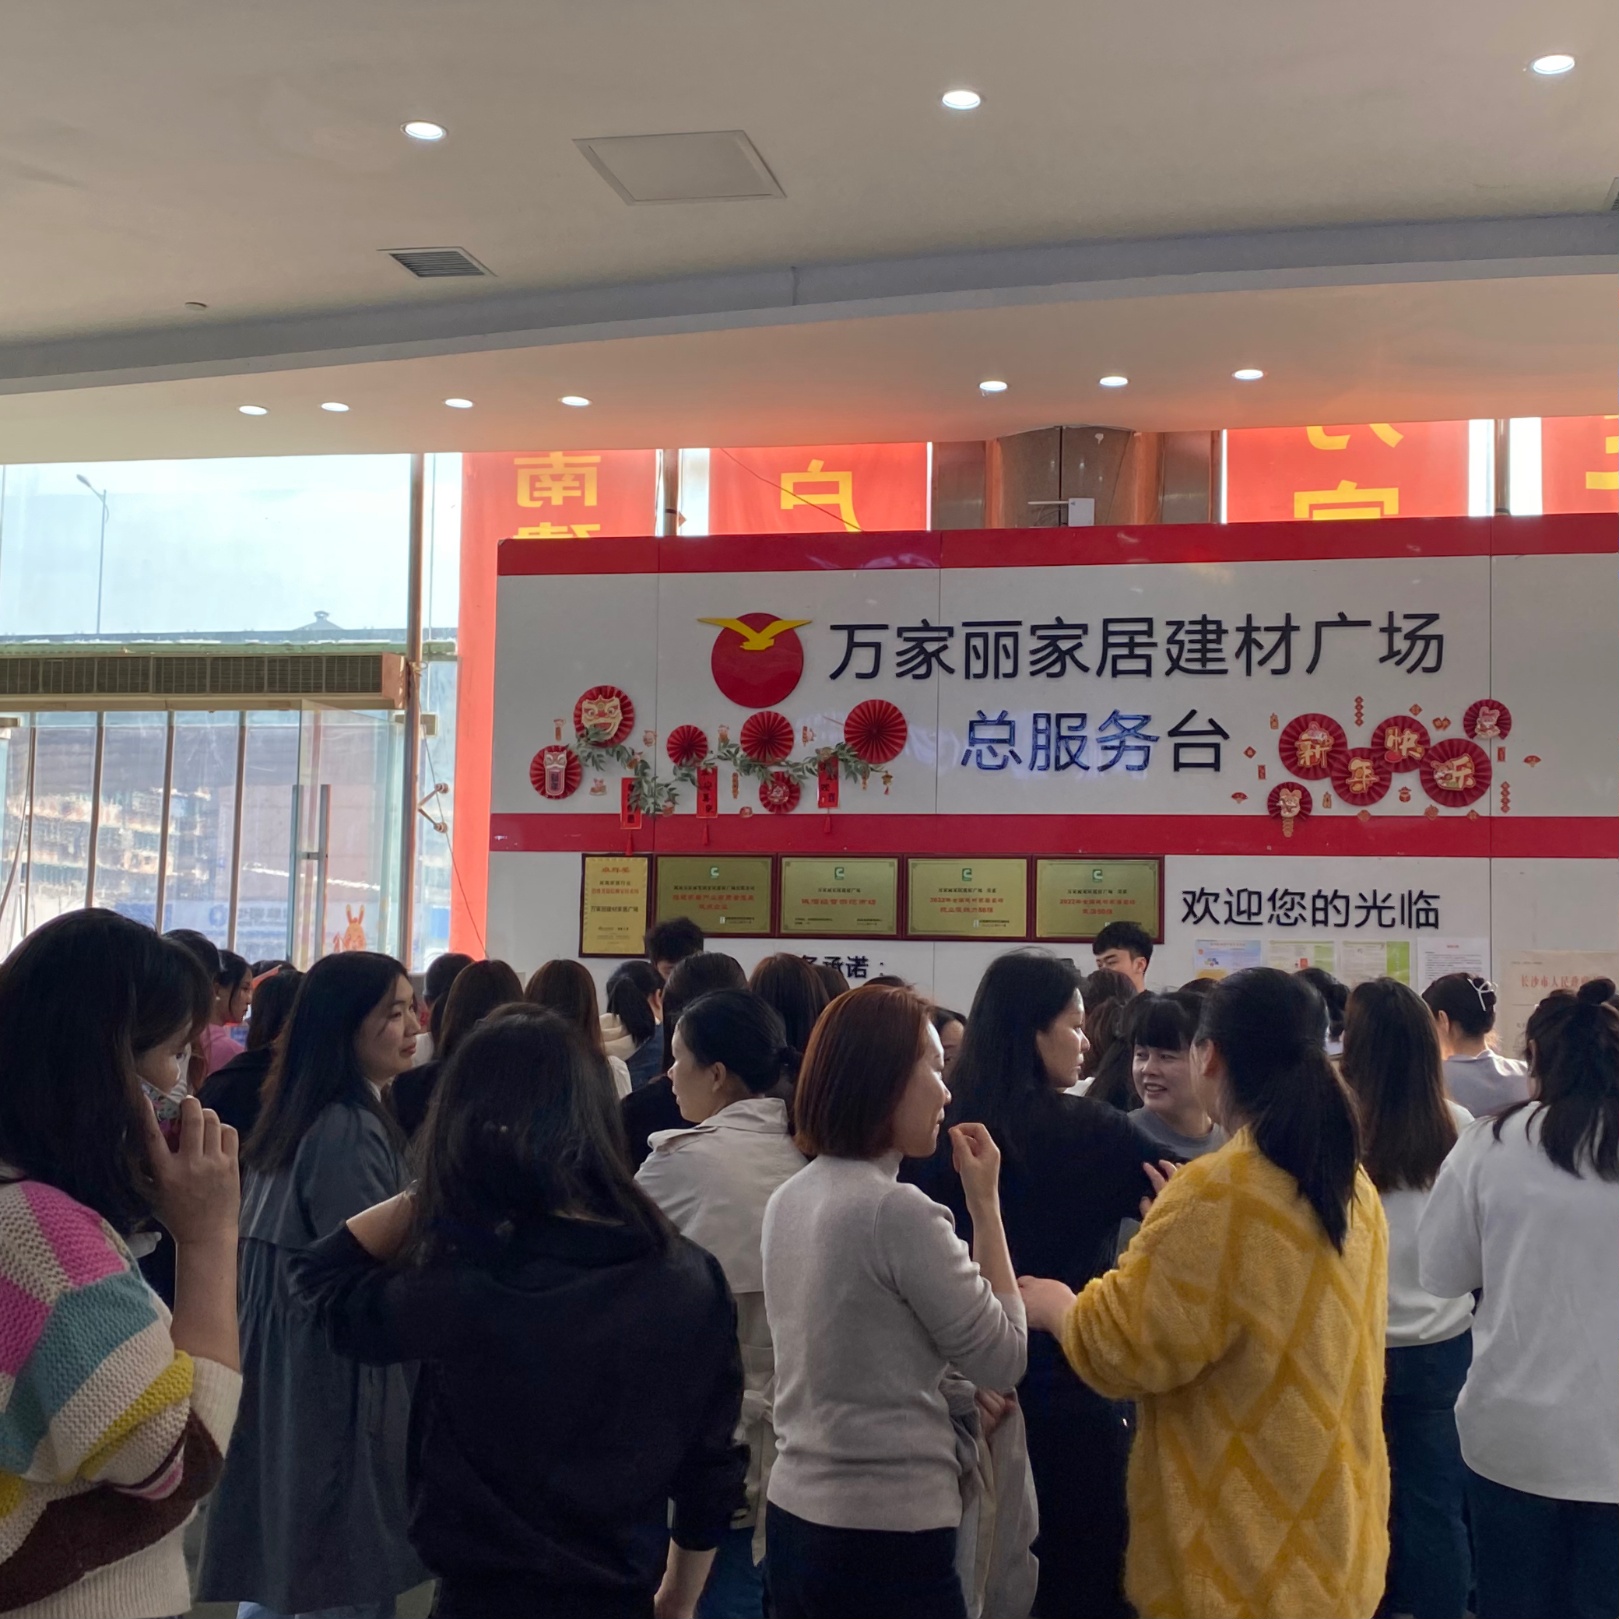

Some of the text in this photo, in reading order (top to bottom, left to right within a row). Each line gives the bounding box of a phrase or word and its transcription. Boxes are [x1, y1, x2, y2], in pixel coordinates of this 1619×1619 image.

[828, 610, 1445, 681] 万家丽家居建材广场
[960, 708, 1231, 774] 总服务台
[1180, 887, 1442, 931] 欢迎您的光临
